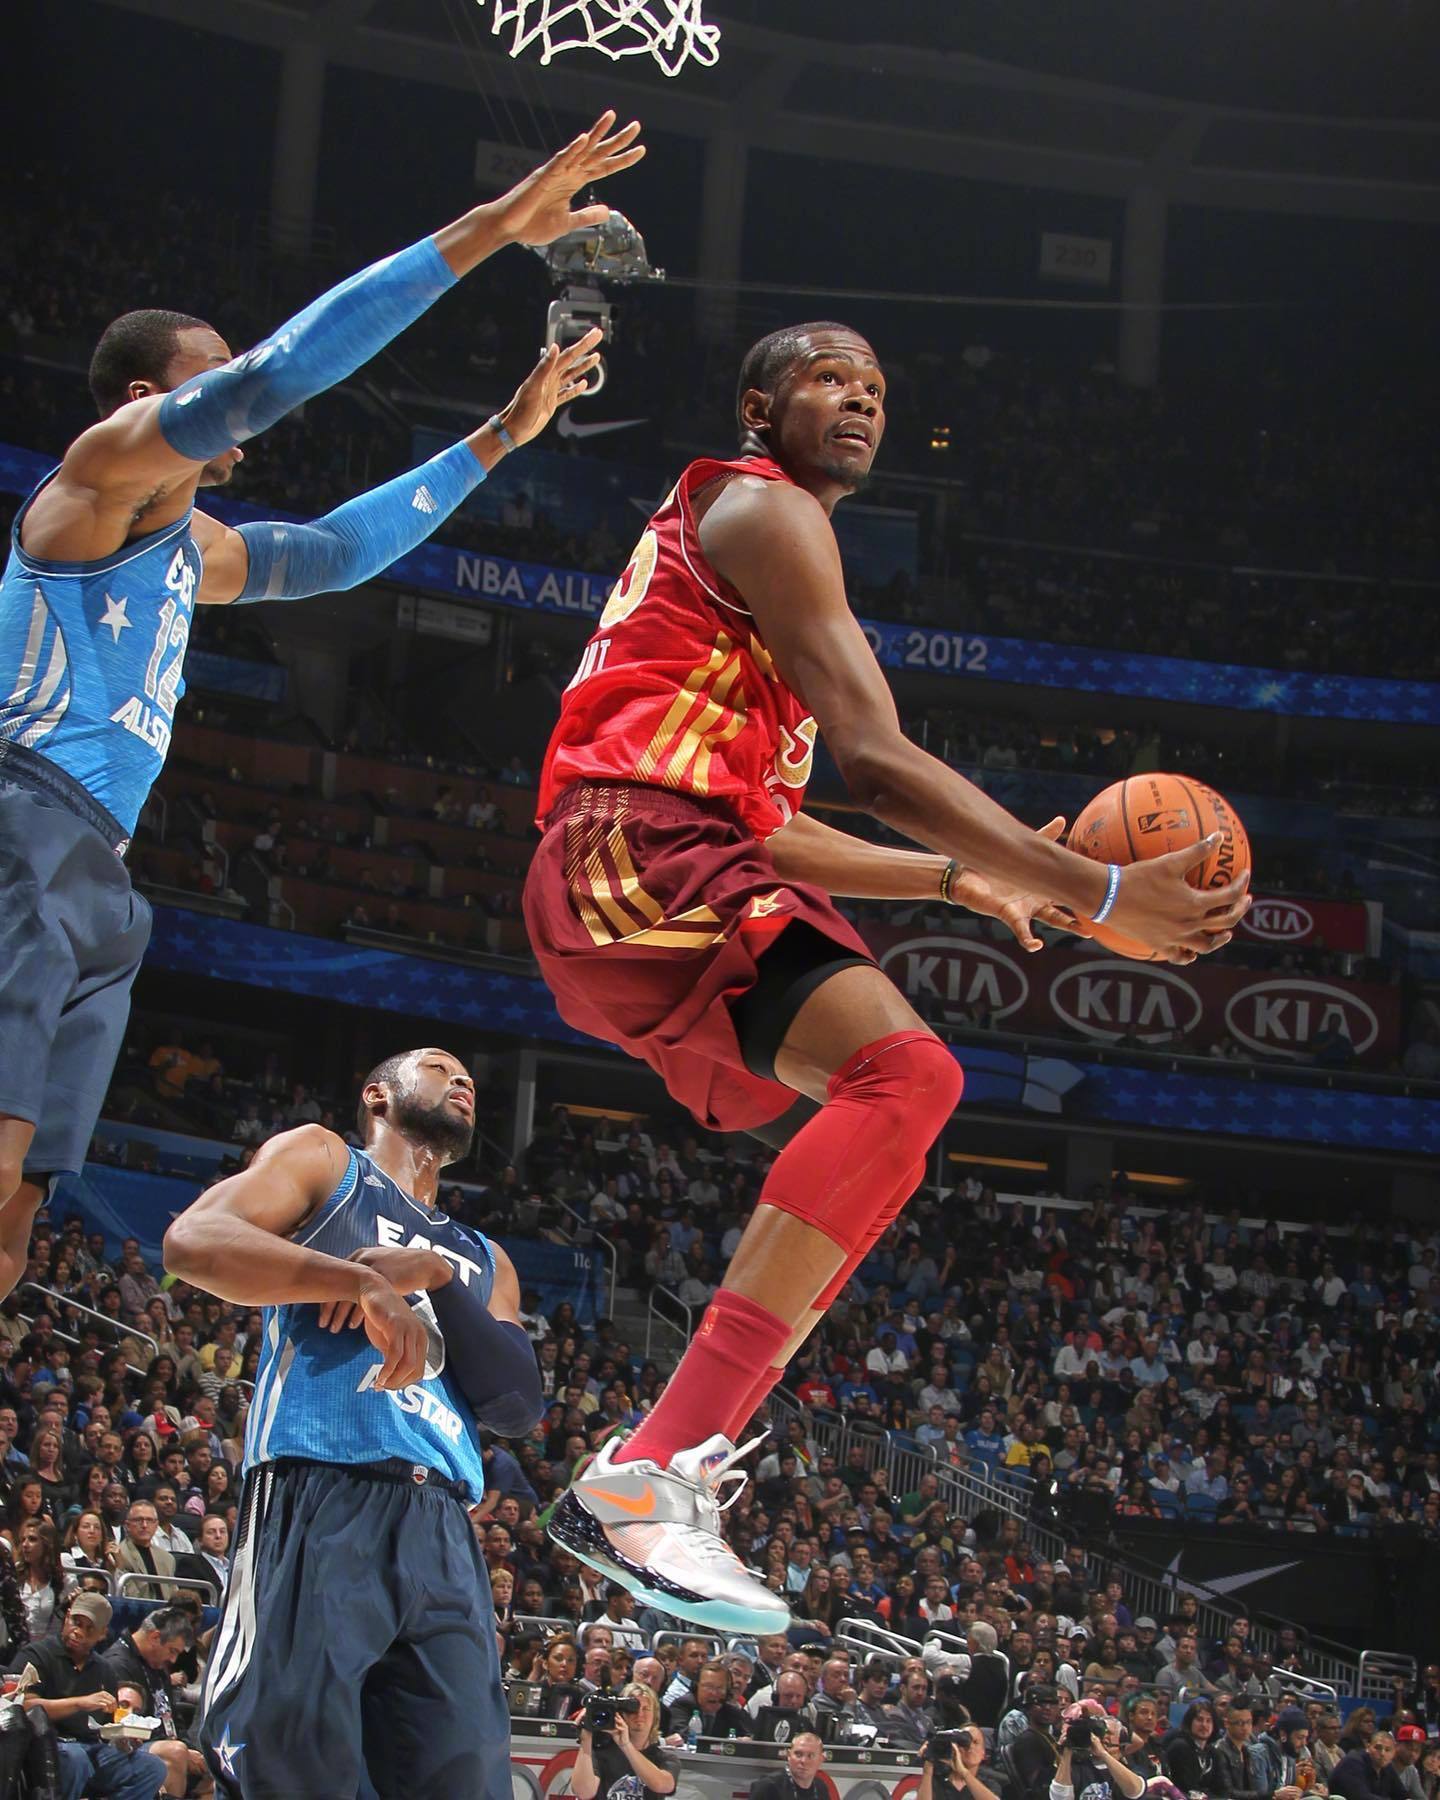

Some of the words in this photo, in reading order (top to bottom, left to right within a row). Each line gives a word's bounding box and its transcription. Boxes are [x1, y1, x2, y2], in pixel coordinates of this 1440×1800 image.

[456, 556, 526, 600] NBA
[535, 572, 620, 612] ALL-
[145, 597, 190, 721] 12
[905, 631, 988, 672] 2012
[1253, 907, 1300, 931] KIA
[906, 953, 1003, 1007] KIA
[1077, 976, 1176, 1028] KIA
[1254, 995, 1353, 1044] KIA
